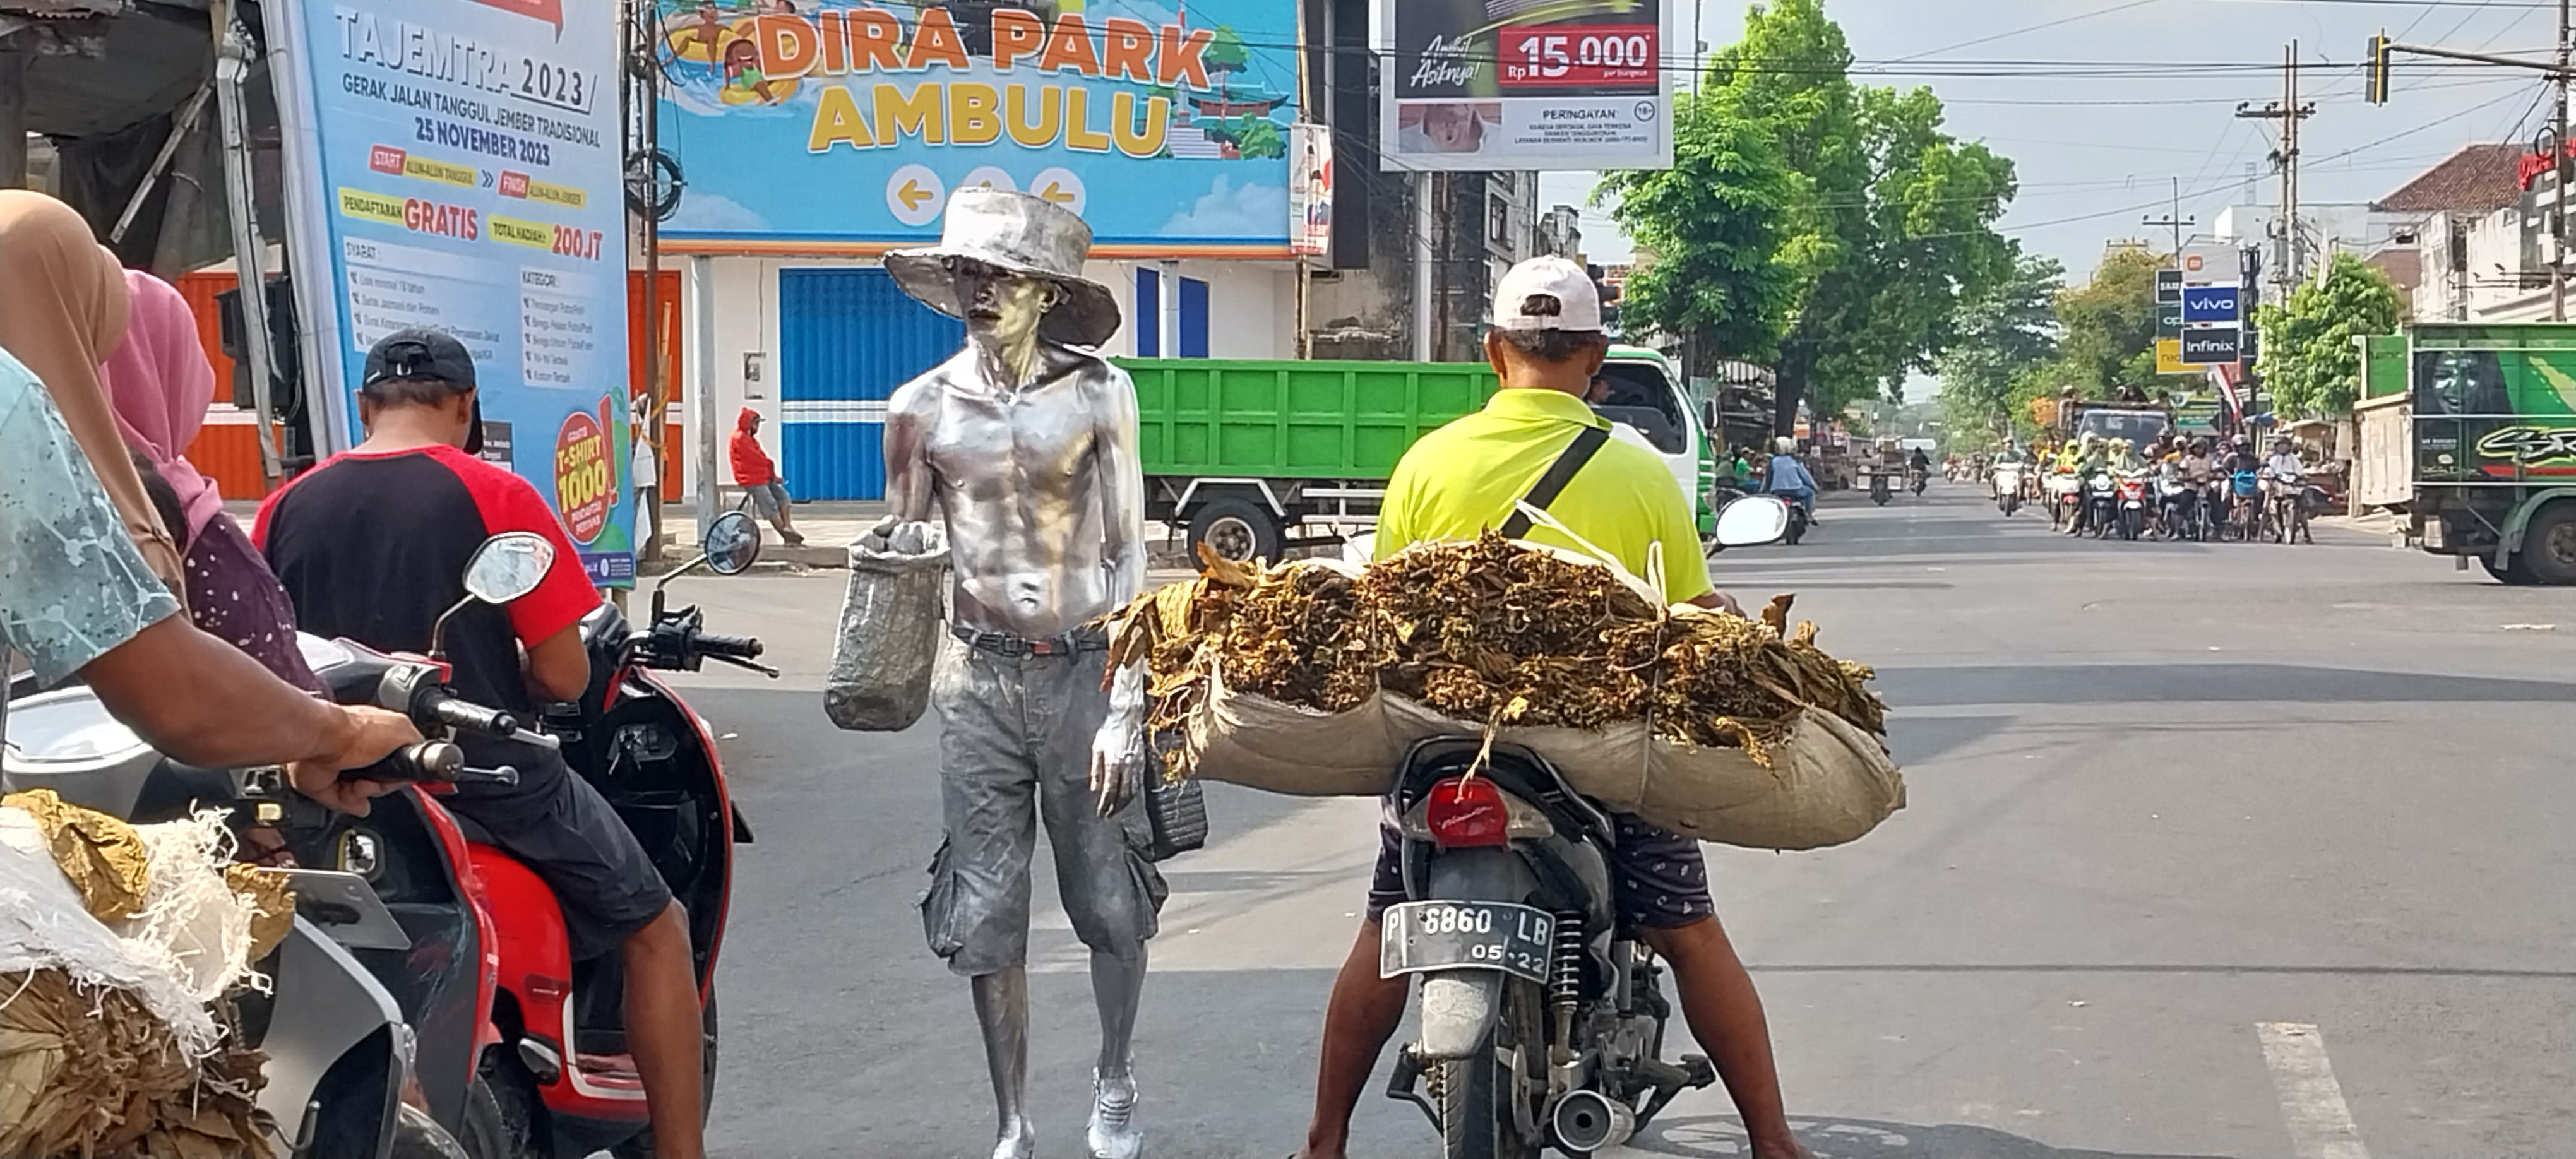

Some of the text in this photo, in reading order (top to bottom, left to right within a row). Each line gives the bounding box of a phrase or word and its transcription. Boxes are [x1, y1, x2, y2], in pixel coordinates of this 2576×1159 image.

[334, 5, 582, 106] TAJEMTRA 2023
[756, 8, 1215, 92] DIRA PARK
[1421, 34, 1472, 63] Ambil
[1410, 55, 1483, 88] Asiknya!
[1508, 66, 1525, 80] Rp
[343, 73, 600, 149] GERAK JALAN TANGGUL JEMBER TRADISIONAL
[808, 82, 1170, 158] AMBULU
[1542, 109, 1616, 120] PERINGATAN
[373, 150, 402, 169] START
[415, 116, 550, 167] 25 NOVEMBER 2023
[343, 195, 479, 241] PENDAFTARAN GRATIS
[492, 222, 515, 239] TOTAL
[2162, 316, 2181, 327] op
[2190, 297, 2234, 310] vivo
[2186, 339, 2235, 352] Infinix
[557, 434, 602, 473] T-SHIRT
[558, 458, 607, 514] 1000
[1388, 907, 1548, 946] P 6860 LB
